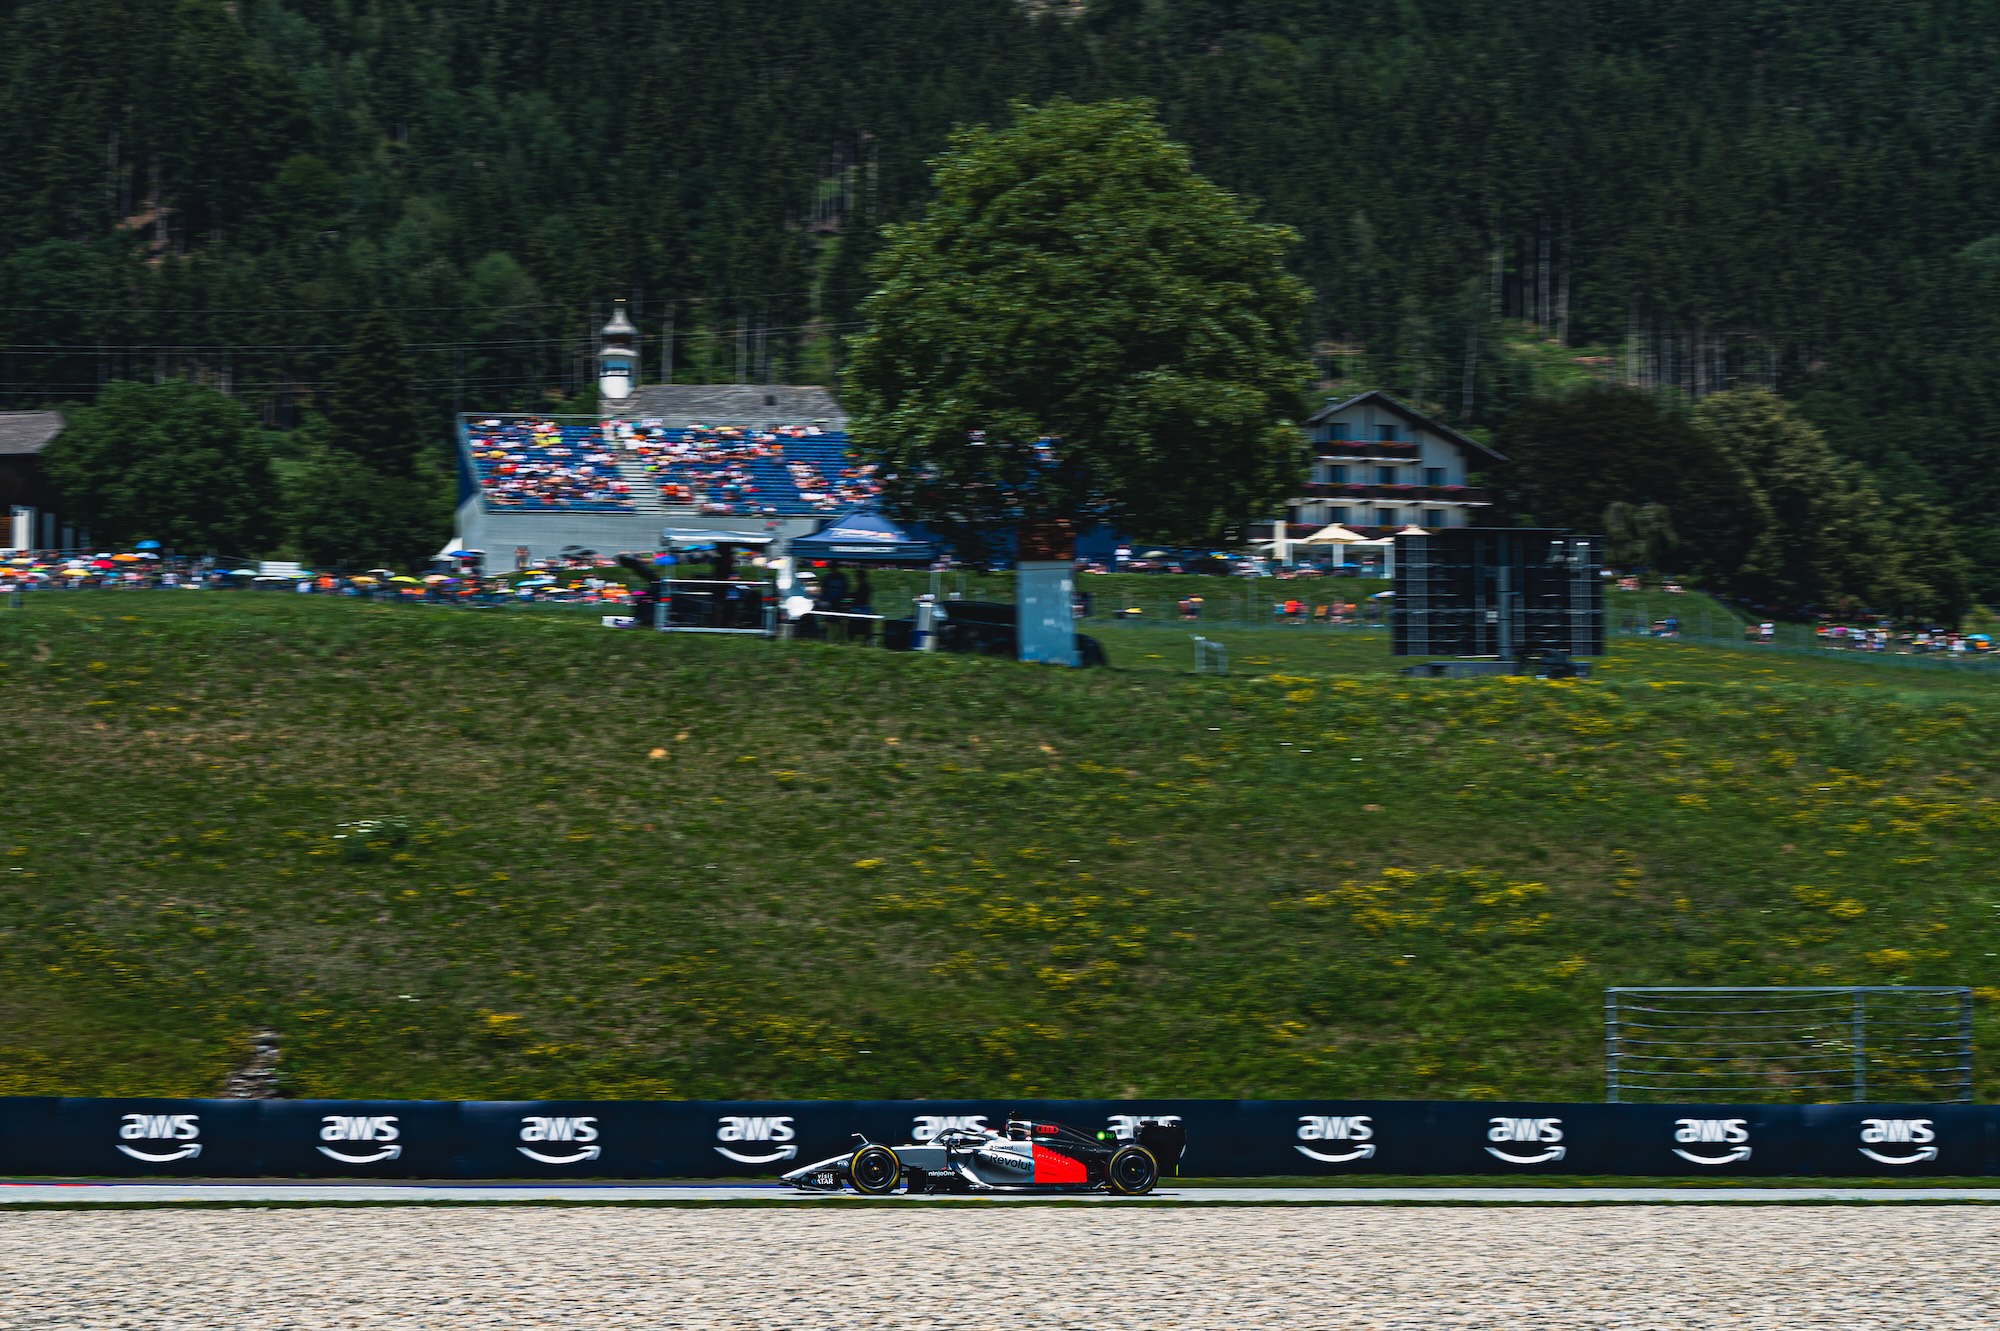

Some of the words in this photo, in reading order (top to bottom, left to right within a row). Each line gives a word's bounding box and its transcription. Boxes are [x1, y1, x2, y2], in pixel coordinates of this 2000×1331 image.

[120, 1113, 199, 1140] aws
[320, 1115, 399, 1142] aws
[520, 1116, 598, 1142] aws
[717, 1116, 795, 1142] aws
[1297, 1115, 1373, 1141] aws
[1488, 1117, 1563, 1143] aws
[1674, 1118, 1749, 1144] aws
[1861, 1118, 1935, 1143] aws
[990, 1153, 1033, 1172] Revolut
